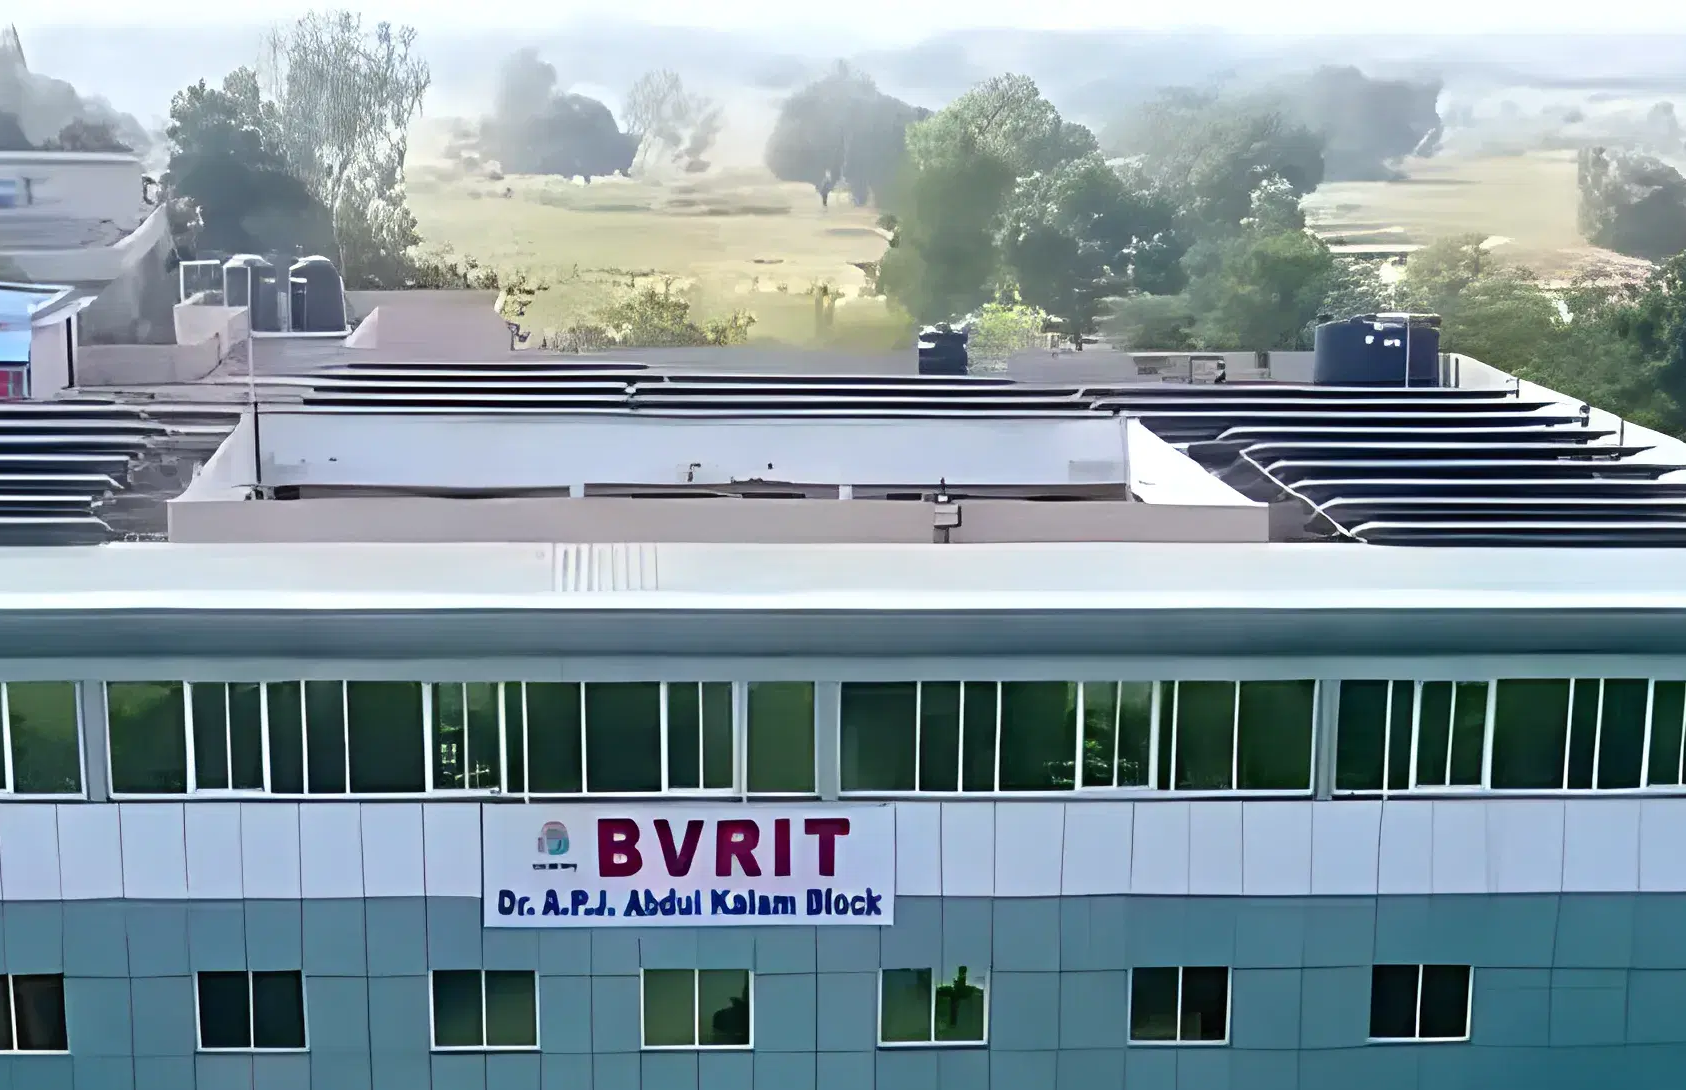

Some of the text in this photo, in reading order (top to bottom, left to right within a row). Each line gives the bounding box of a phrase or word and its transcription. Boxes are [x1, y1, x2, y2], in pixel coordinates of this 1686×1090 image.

[597, 817, 851, 878] BVRIT
[497, 887, 882, 917] Dr. A.P.J. Abdul Kalam Block
